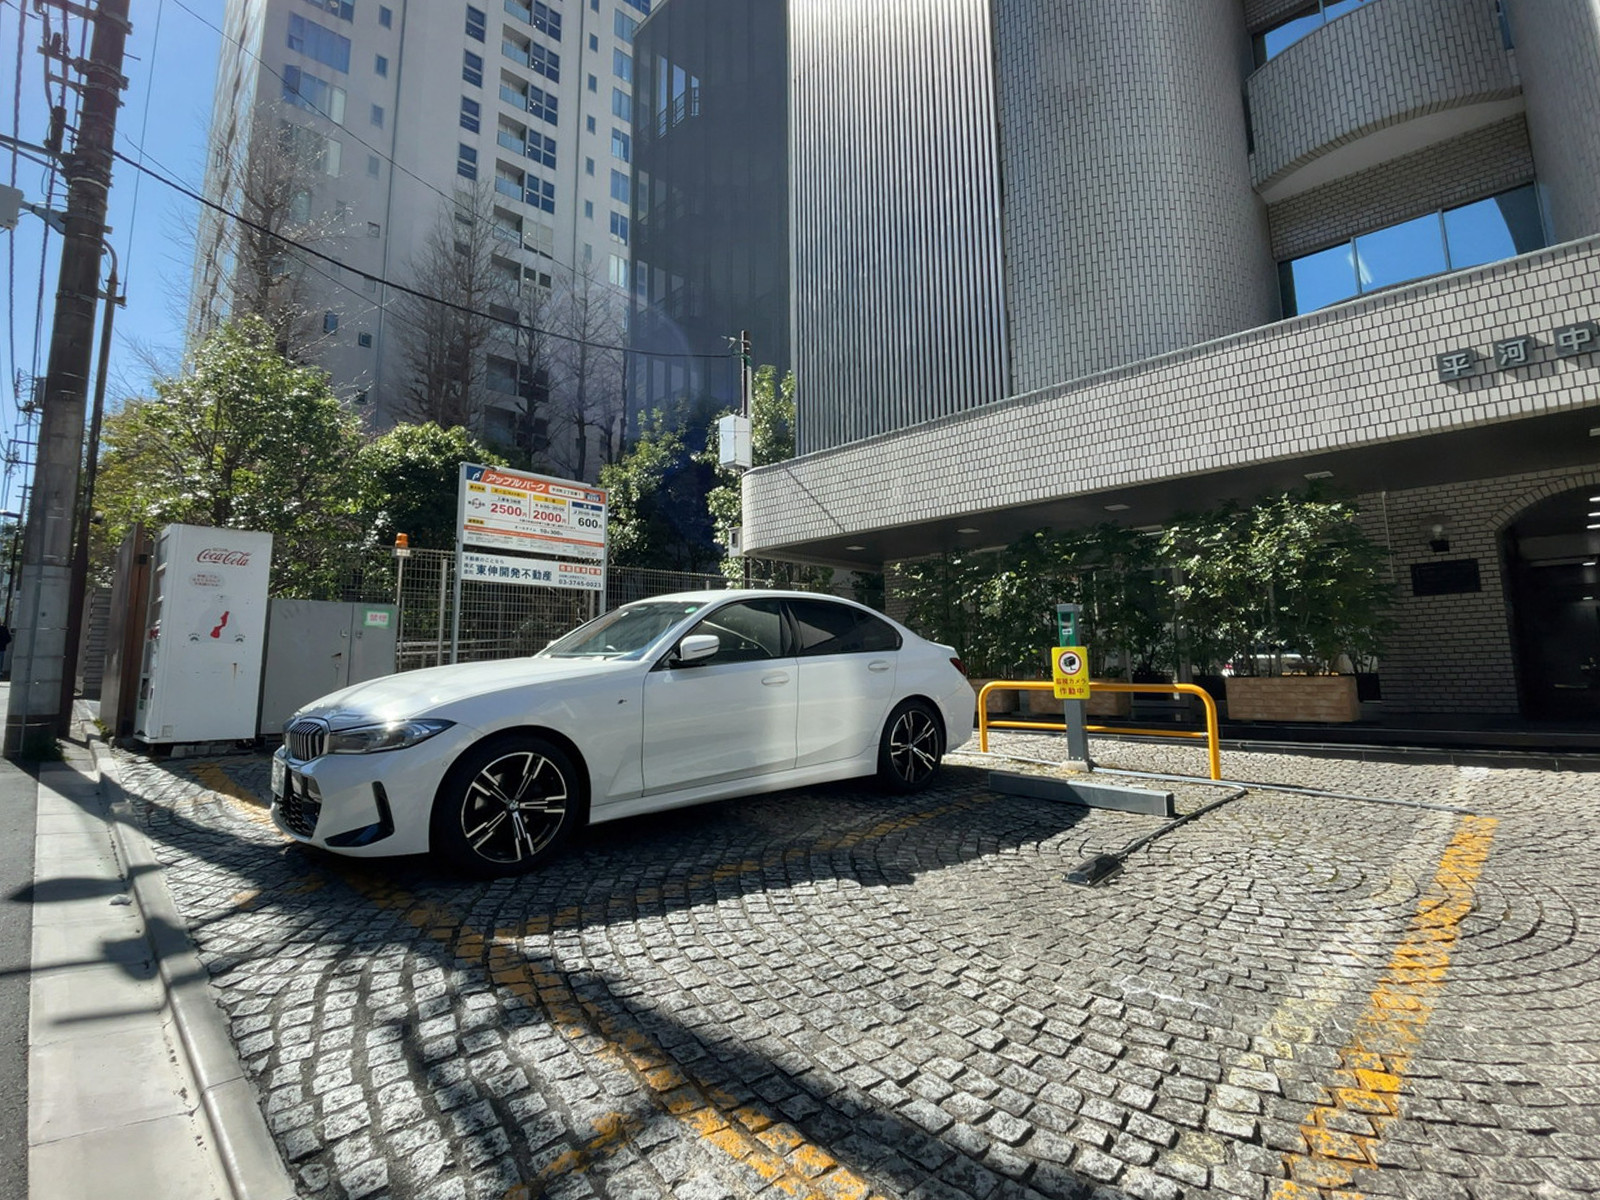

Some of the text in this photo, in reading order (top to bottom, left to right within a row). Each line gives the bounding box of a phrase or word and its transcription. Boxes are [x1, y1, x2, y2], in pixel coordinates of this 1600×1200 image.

[486, 473, 546, 491] アップルパーク
[476, 563, 552, 581] 東伸開発不動産
[1059, 687, 1084, 696] 作動中
